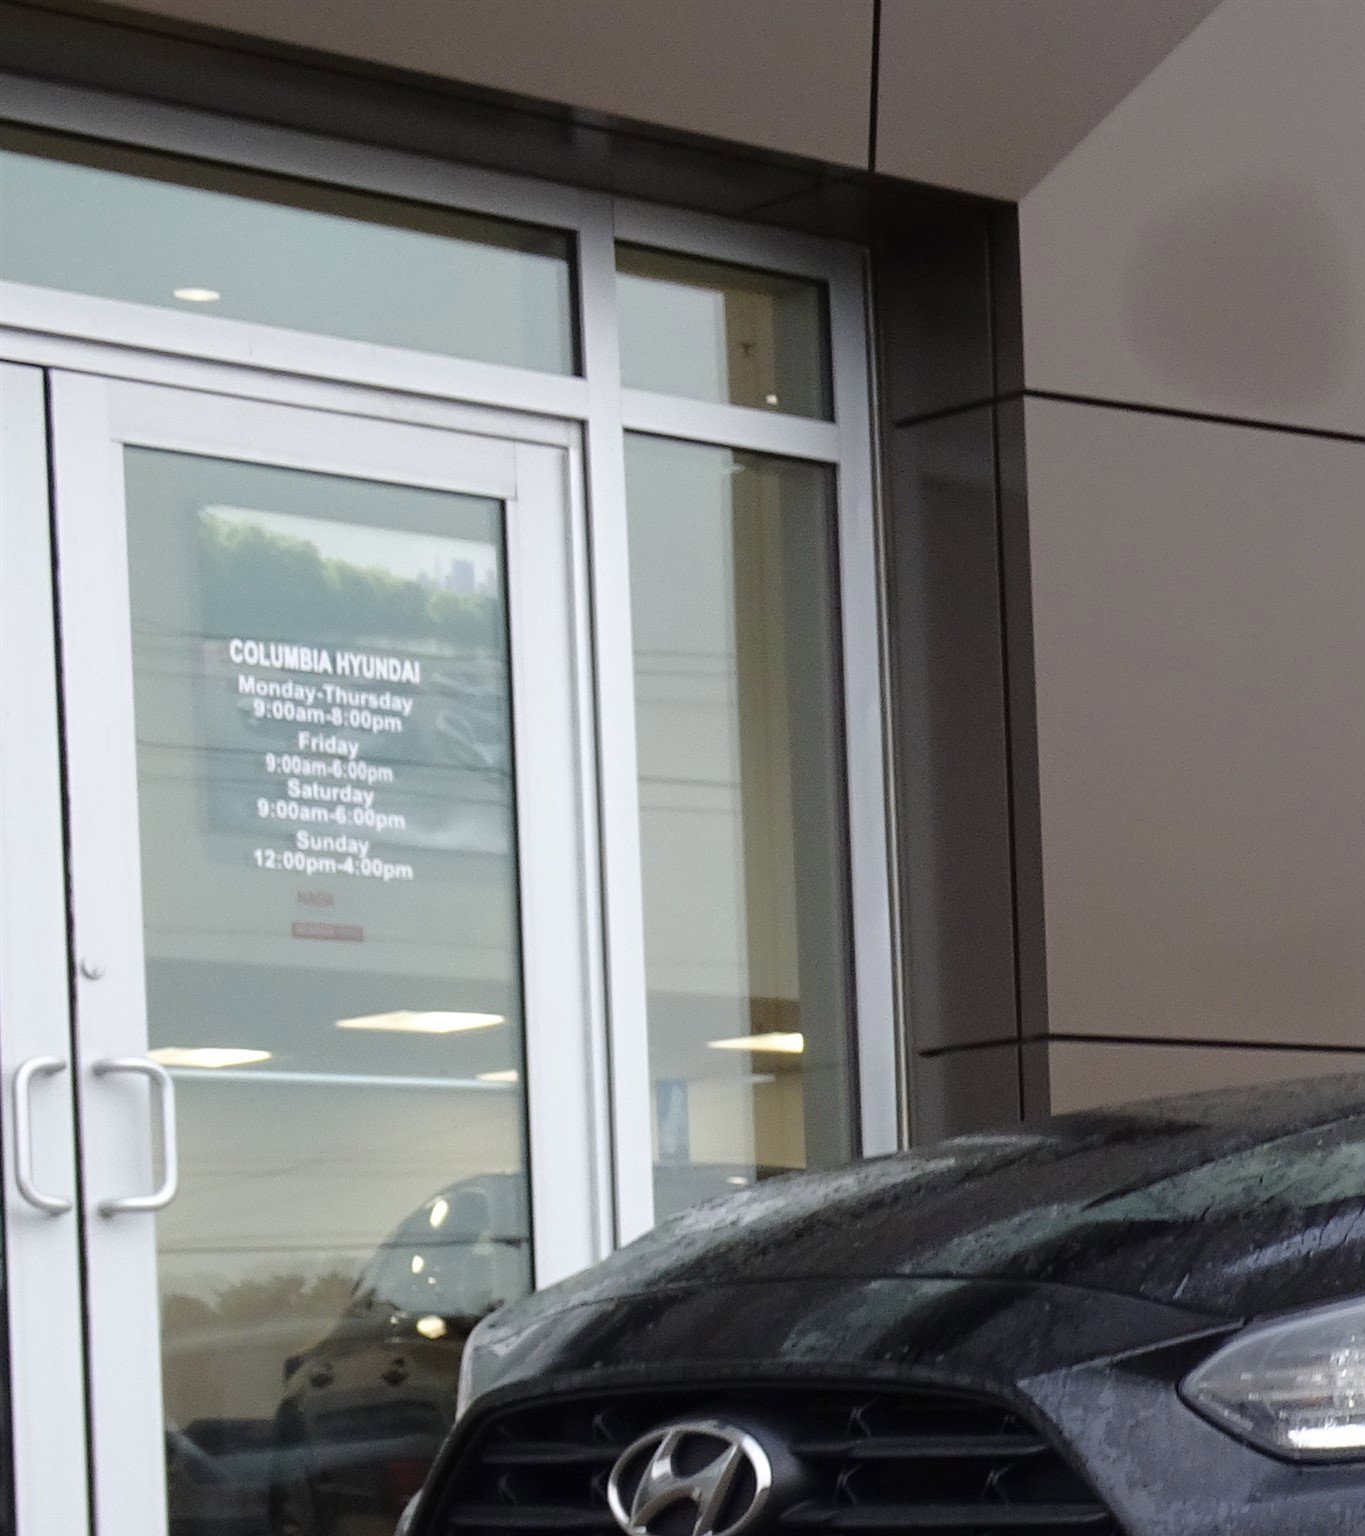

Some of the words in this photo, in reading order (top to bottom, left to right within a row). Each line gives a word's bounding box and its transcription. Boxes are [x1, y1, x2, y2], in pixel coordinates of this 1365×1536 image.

[229, 638, 332, 674] COLUMBIA
[336, 652, 420, 684] HYUNDAI
[238, 675, 414, 715] Monday-Thursday
[253, 700, 402, 732] 9:00am-8:00pm
[298, 730, 359, 758] Friday
[265, 753, 394, 784] 9:00am-6:00pm
[287, 778, 374, 808] Saturday
[257, 798, 406, 831] 9:00am-6:00pm
[296, 829, 369, 857] Sunday
[254, 849, 414, 881] 12:00pm-4:00pm
